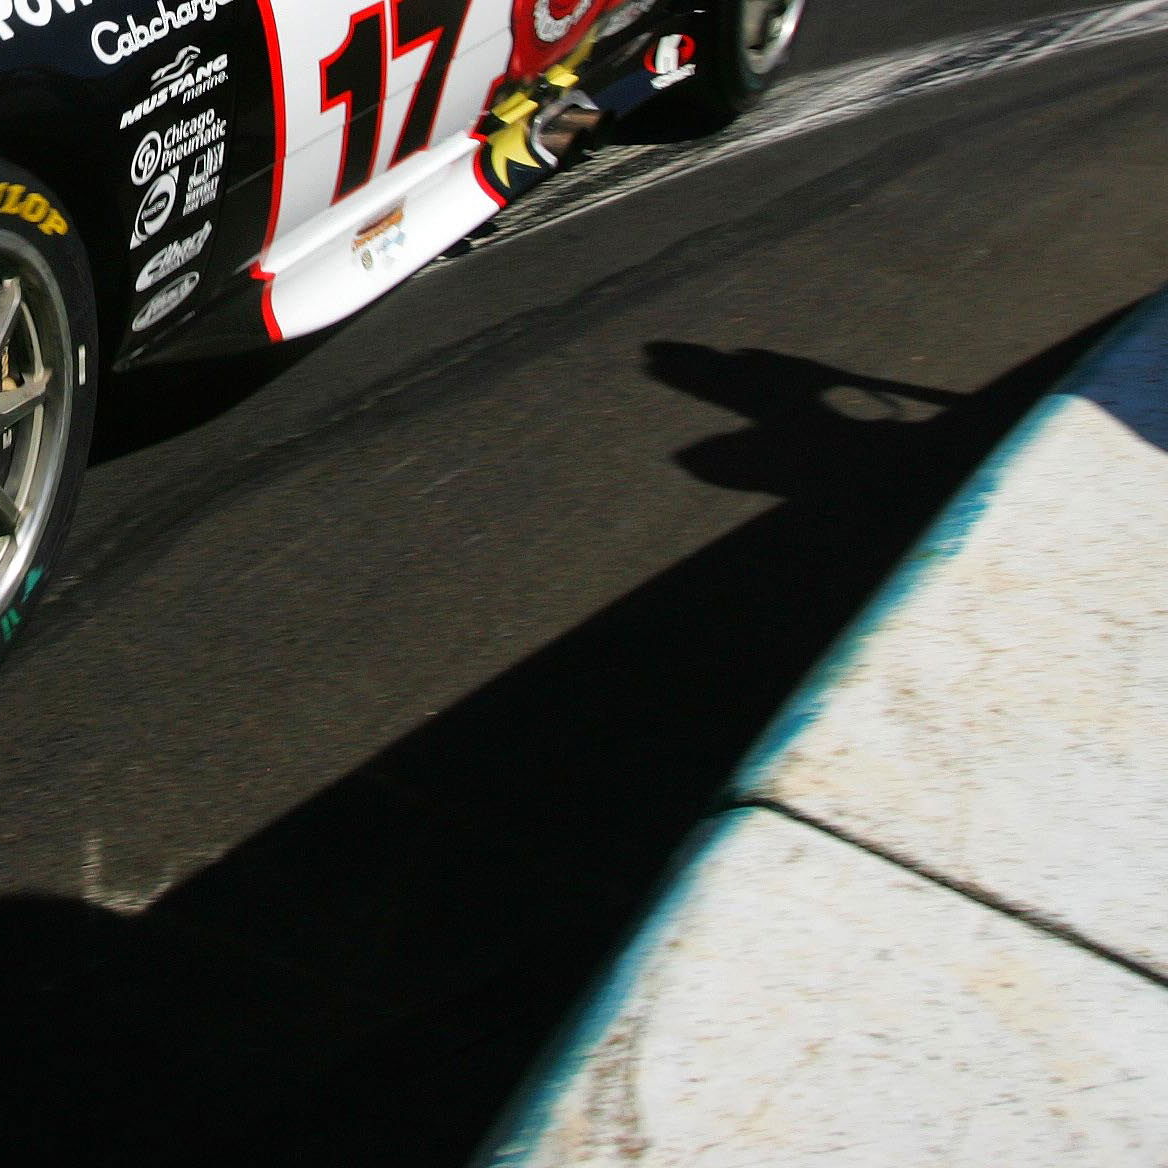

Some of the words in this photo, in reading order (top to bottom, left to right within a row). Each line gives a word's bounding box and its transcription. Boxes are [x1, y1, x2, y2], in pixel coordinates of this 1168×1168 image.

[119, 53, 228, 130] MUSTANG
[160, 117, 227, 172] Pneumatic
[163, 108, 215, 150] Chicago
